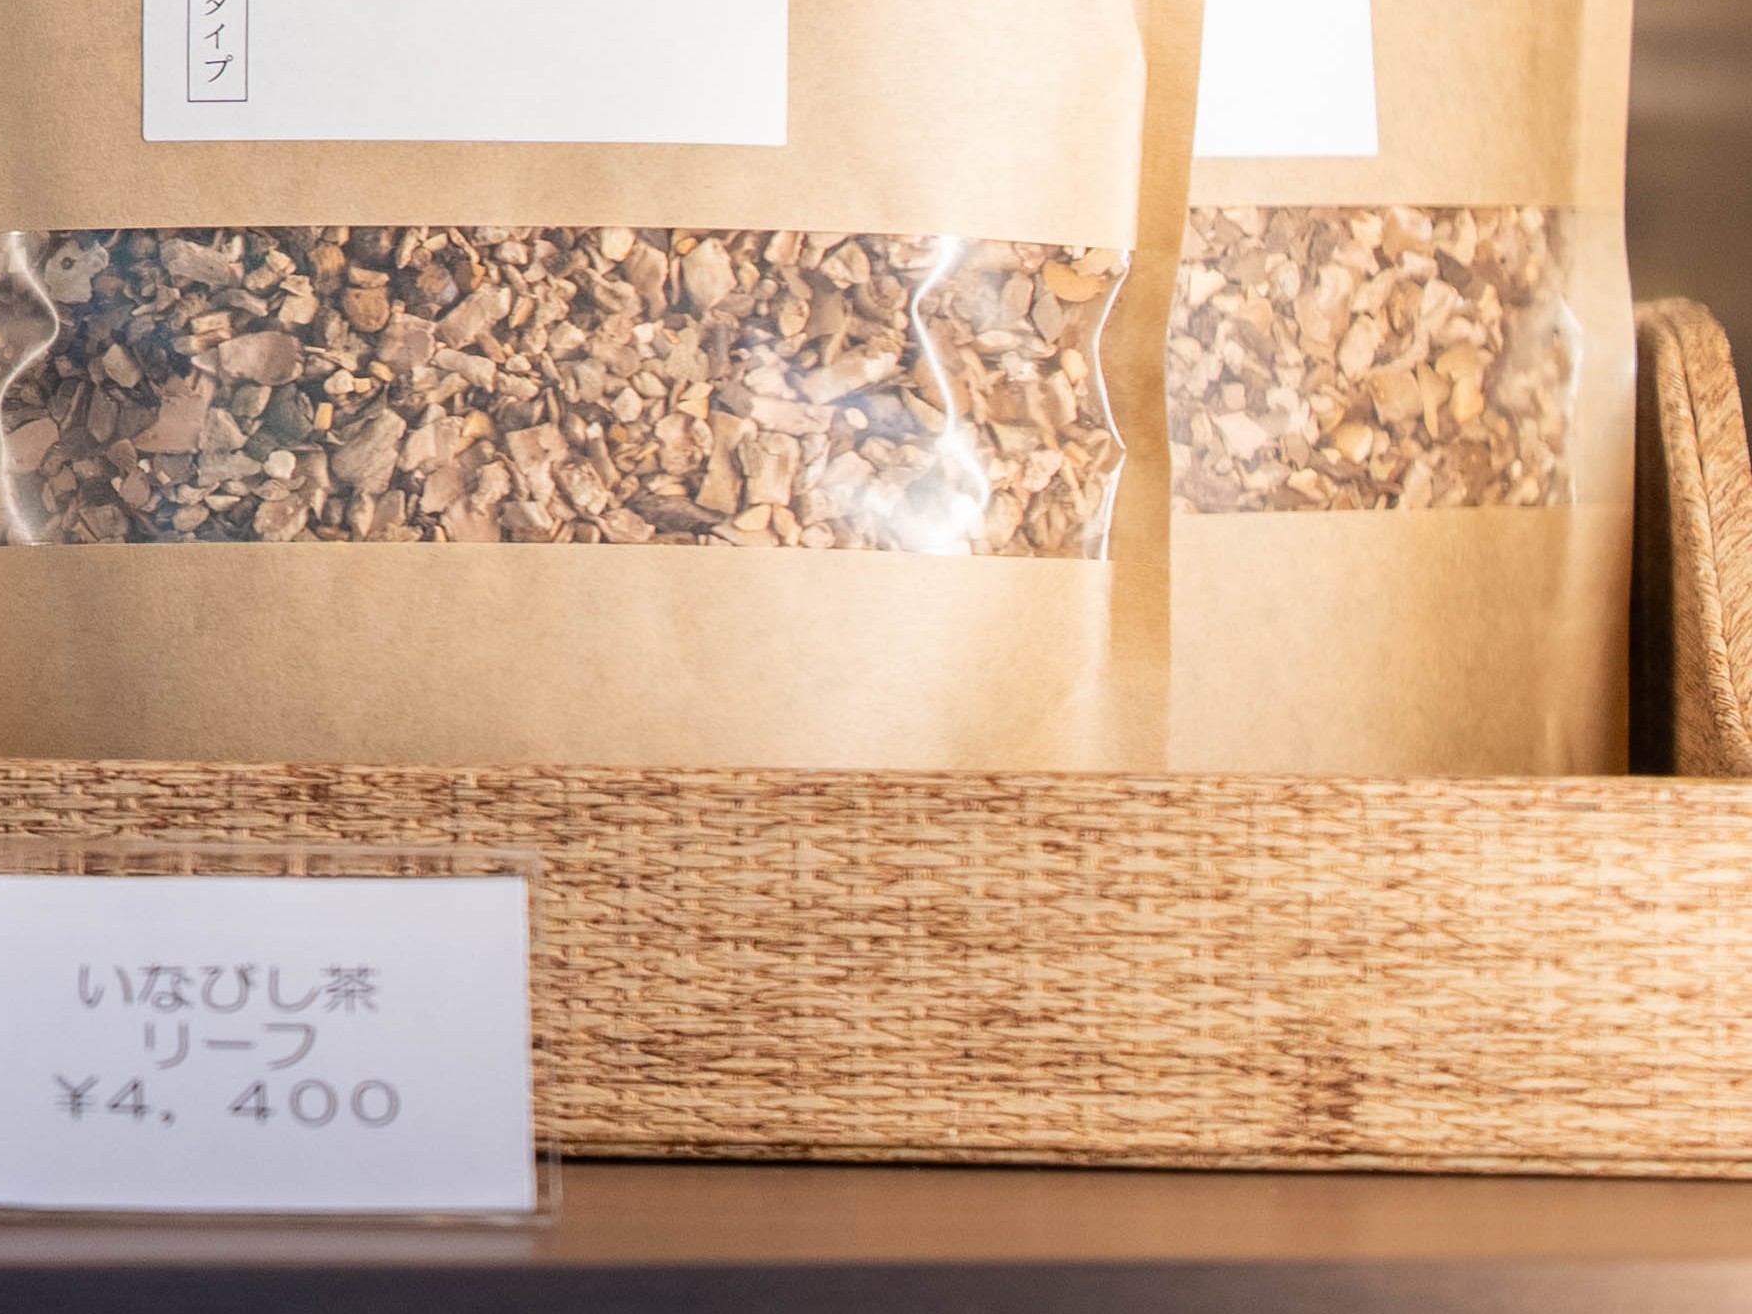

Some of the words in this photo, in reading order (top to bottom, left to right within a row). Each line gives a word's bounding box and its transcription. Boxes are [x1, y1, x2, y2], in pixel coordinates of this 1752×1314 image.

[77, 963, 378, 1014] いなびし茶
[143, 1021, 318, 1071] リーフ
